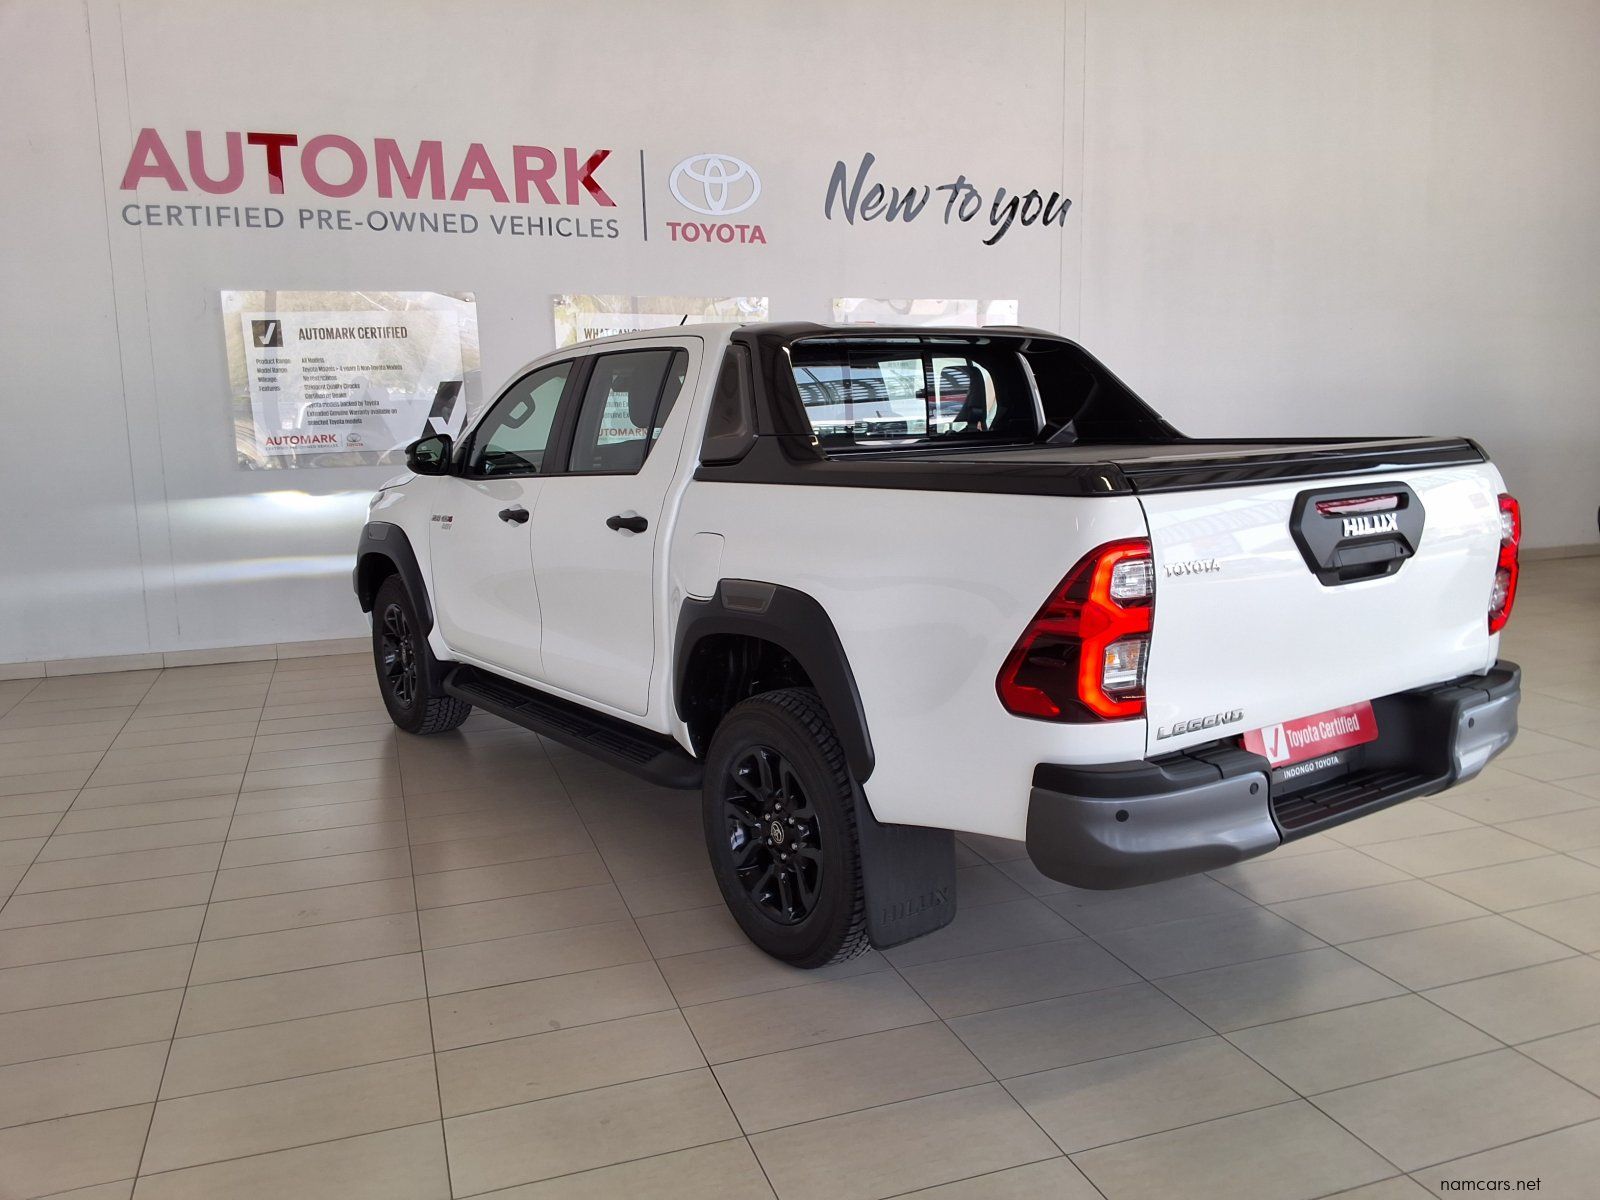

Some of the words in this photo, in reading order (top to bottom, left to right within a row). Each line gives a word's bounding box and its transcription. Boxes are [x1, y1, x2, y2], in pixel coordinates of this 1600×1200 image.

[120, 128, 617, 207] AUTOMARK
[824, 152, 930, 225] New
[936, 174, 982, 225] to
[983, 187, 1072, 246] you
[122, 204, 284, 229] CERTIFIED
[299, 210, 478, 234] PRE-OWNED
[490, 216, 620, 239] VEHICLES
[666, 222, 766, 244] TOYOTA
[298, 328, 356, 340] AUTOMARK
[358, 326, 408, 339] CERTIFIED
[266, 434, 337, 446] AUTOMARK
[1342, 513, 1398, 537] HILUX
[1164, 558, 1220, 578] TOYOTA
[1157, 708, 1244, 740] LEGEND
[1287, 724, 1318, 748] Toyota
[1319, 714, 1360, 739] Certified
[1284, 763, 1314, 778] INDONGO
[1315, 756, 1339, 770] TOYOTA
